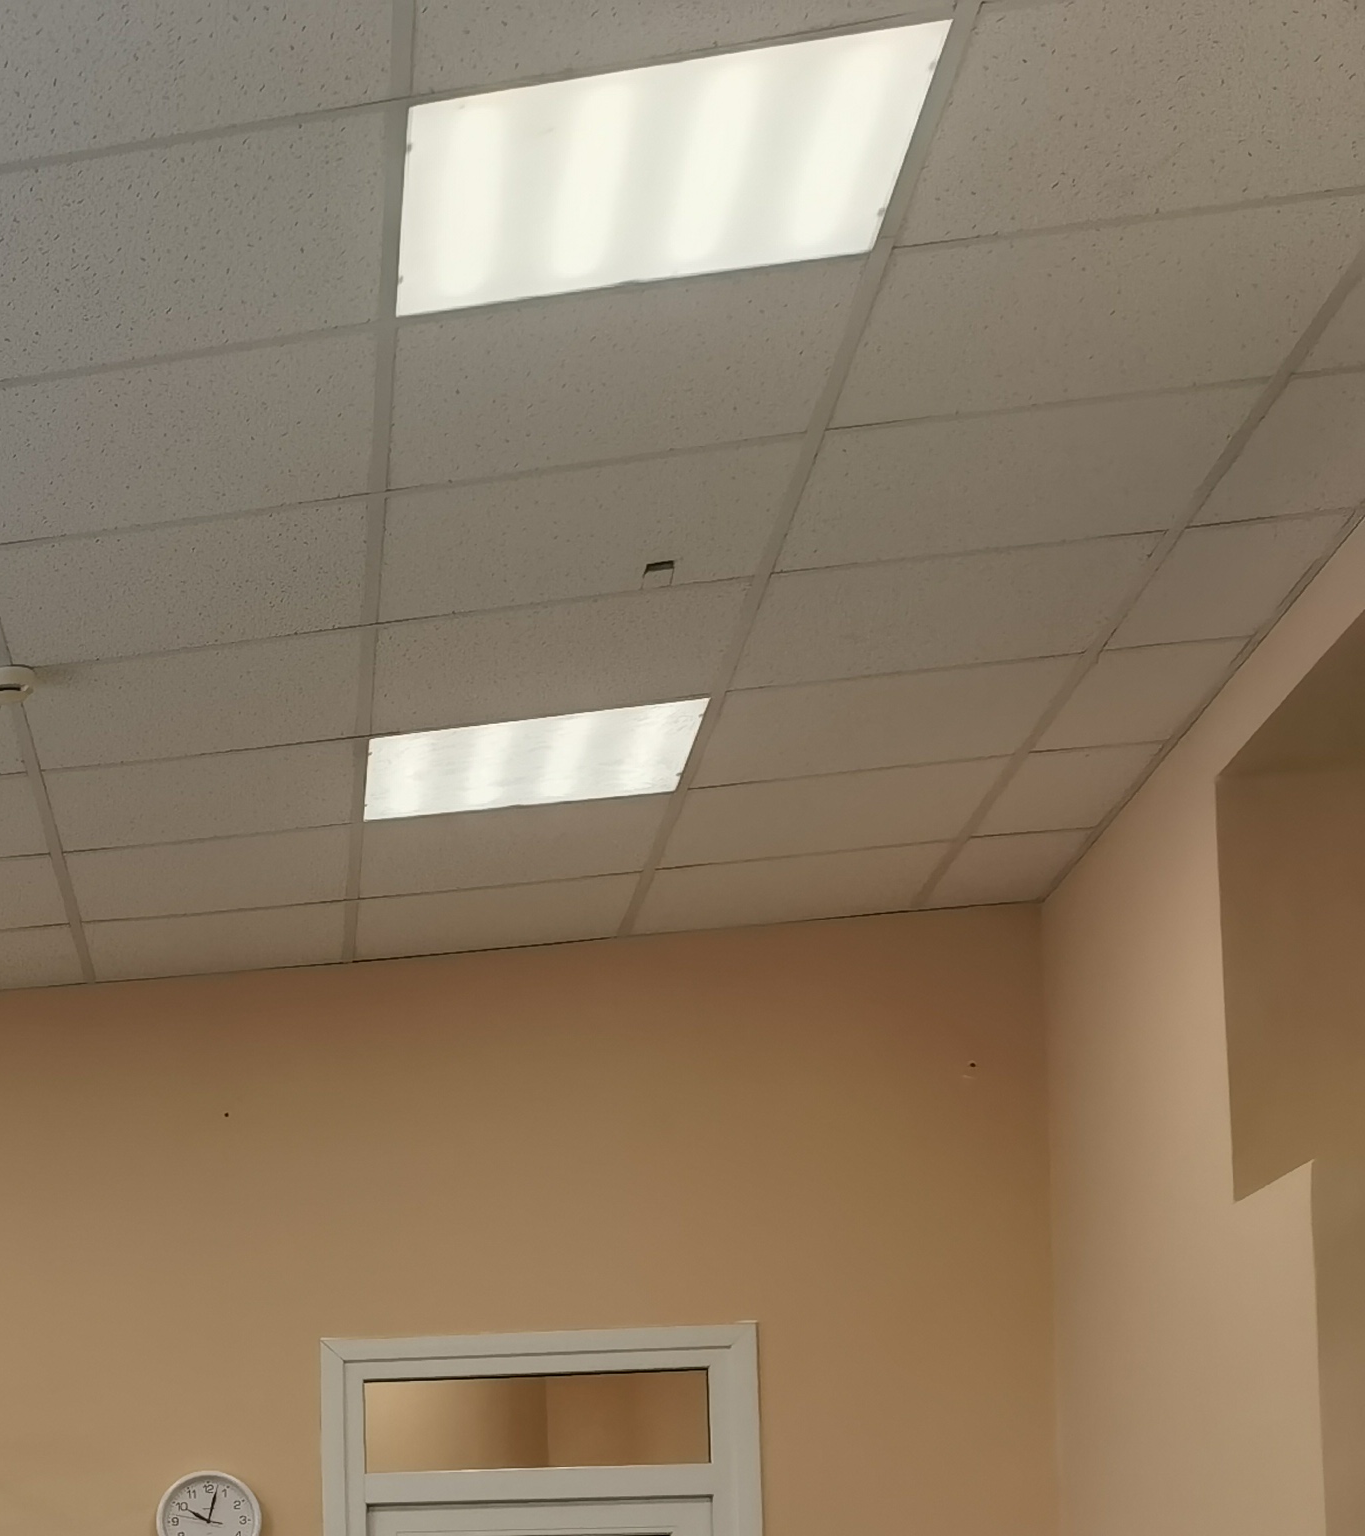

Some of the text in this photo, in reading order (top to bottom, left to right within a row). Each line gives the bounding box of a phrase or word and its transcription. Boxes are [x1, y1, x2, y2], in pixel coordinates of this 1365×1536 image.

[203, 1484, 214, 1493] 12
[222, 1488, 227, 1498] 1
[187, 1489, 197, 1499] 11
[176, 1502, 188, 1511] 10
[233, 1500, 241, 1509] 2
[171, 1517, 179, 1526] 9
[239, 1515, 247, 1525] 3
